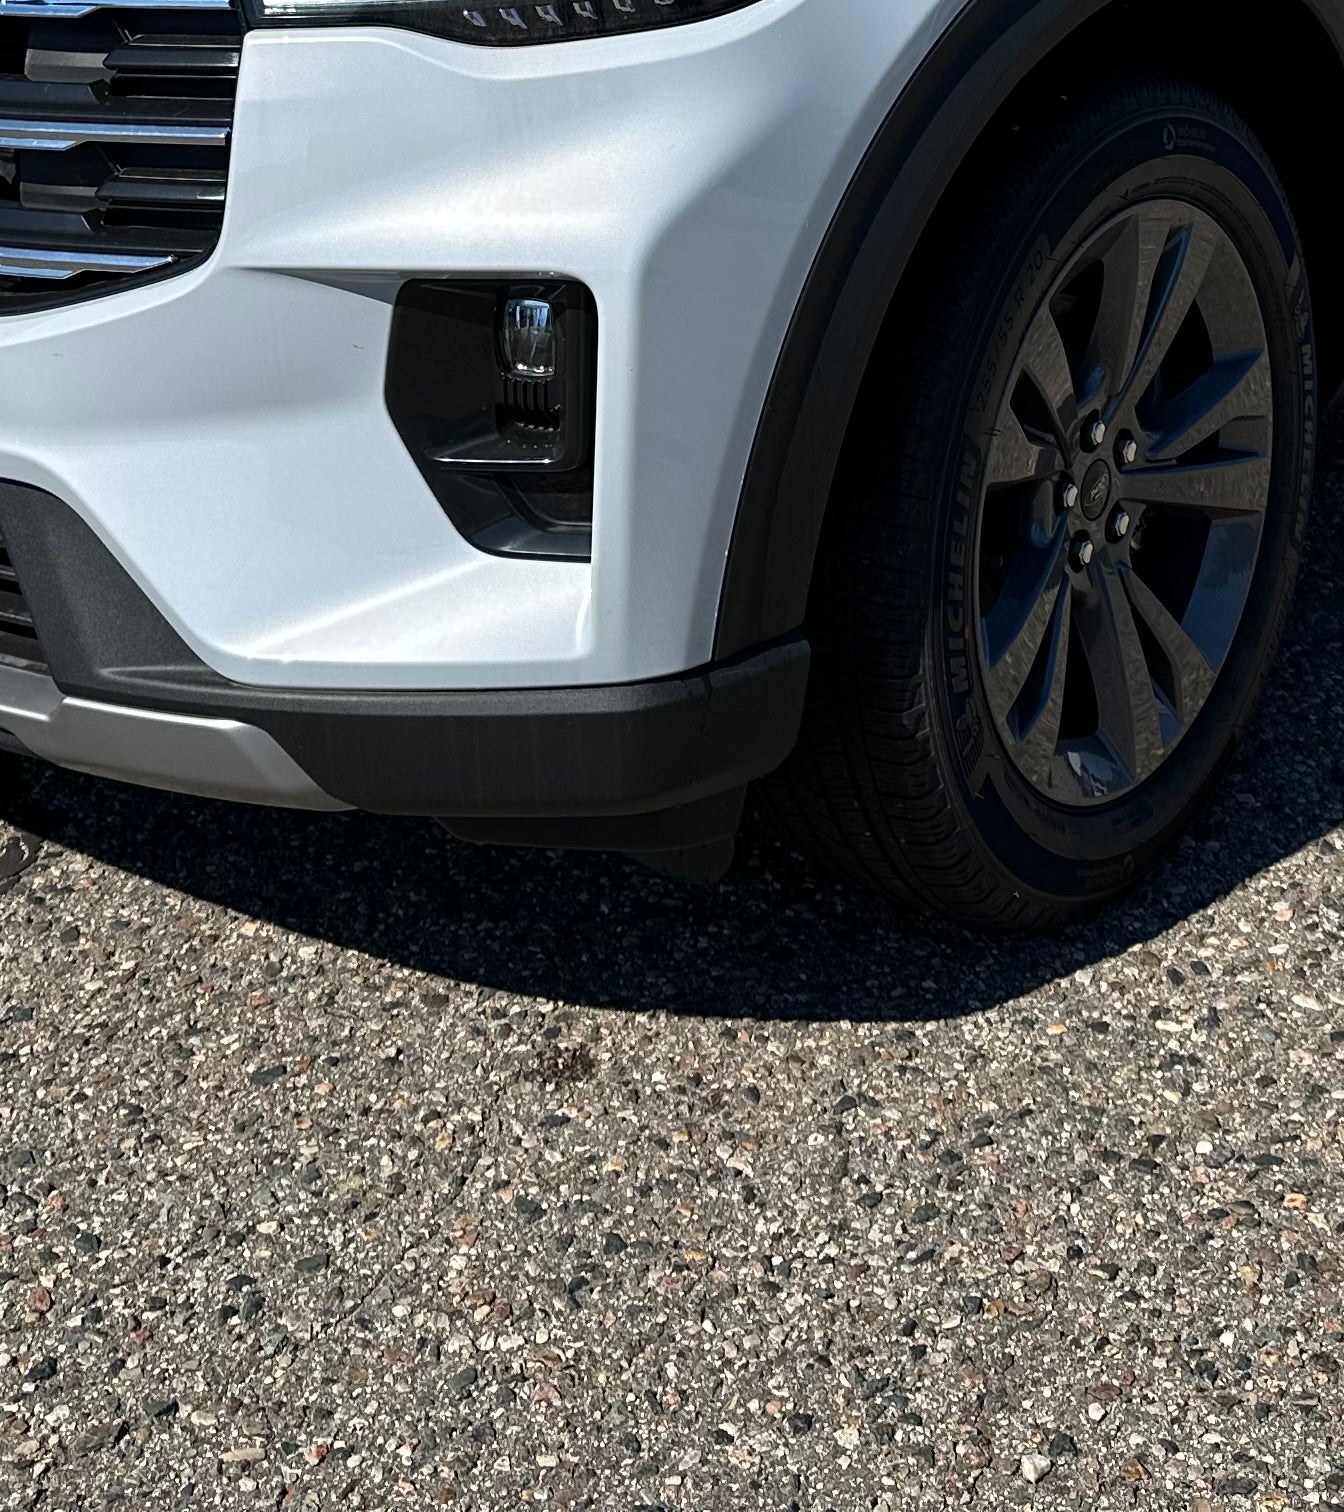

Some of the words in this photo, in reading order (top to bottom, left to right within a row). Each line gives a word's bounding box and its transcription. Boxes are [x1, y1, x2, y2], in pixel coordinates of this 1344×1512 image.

[1015, 287, 1025, 310] R
[1027, 250, 1043, 285] 20
[1292, 343, 1314, 548] MICHELIN
[946, 450, 977, 695] MICHELIN
